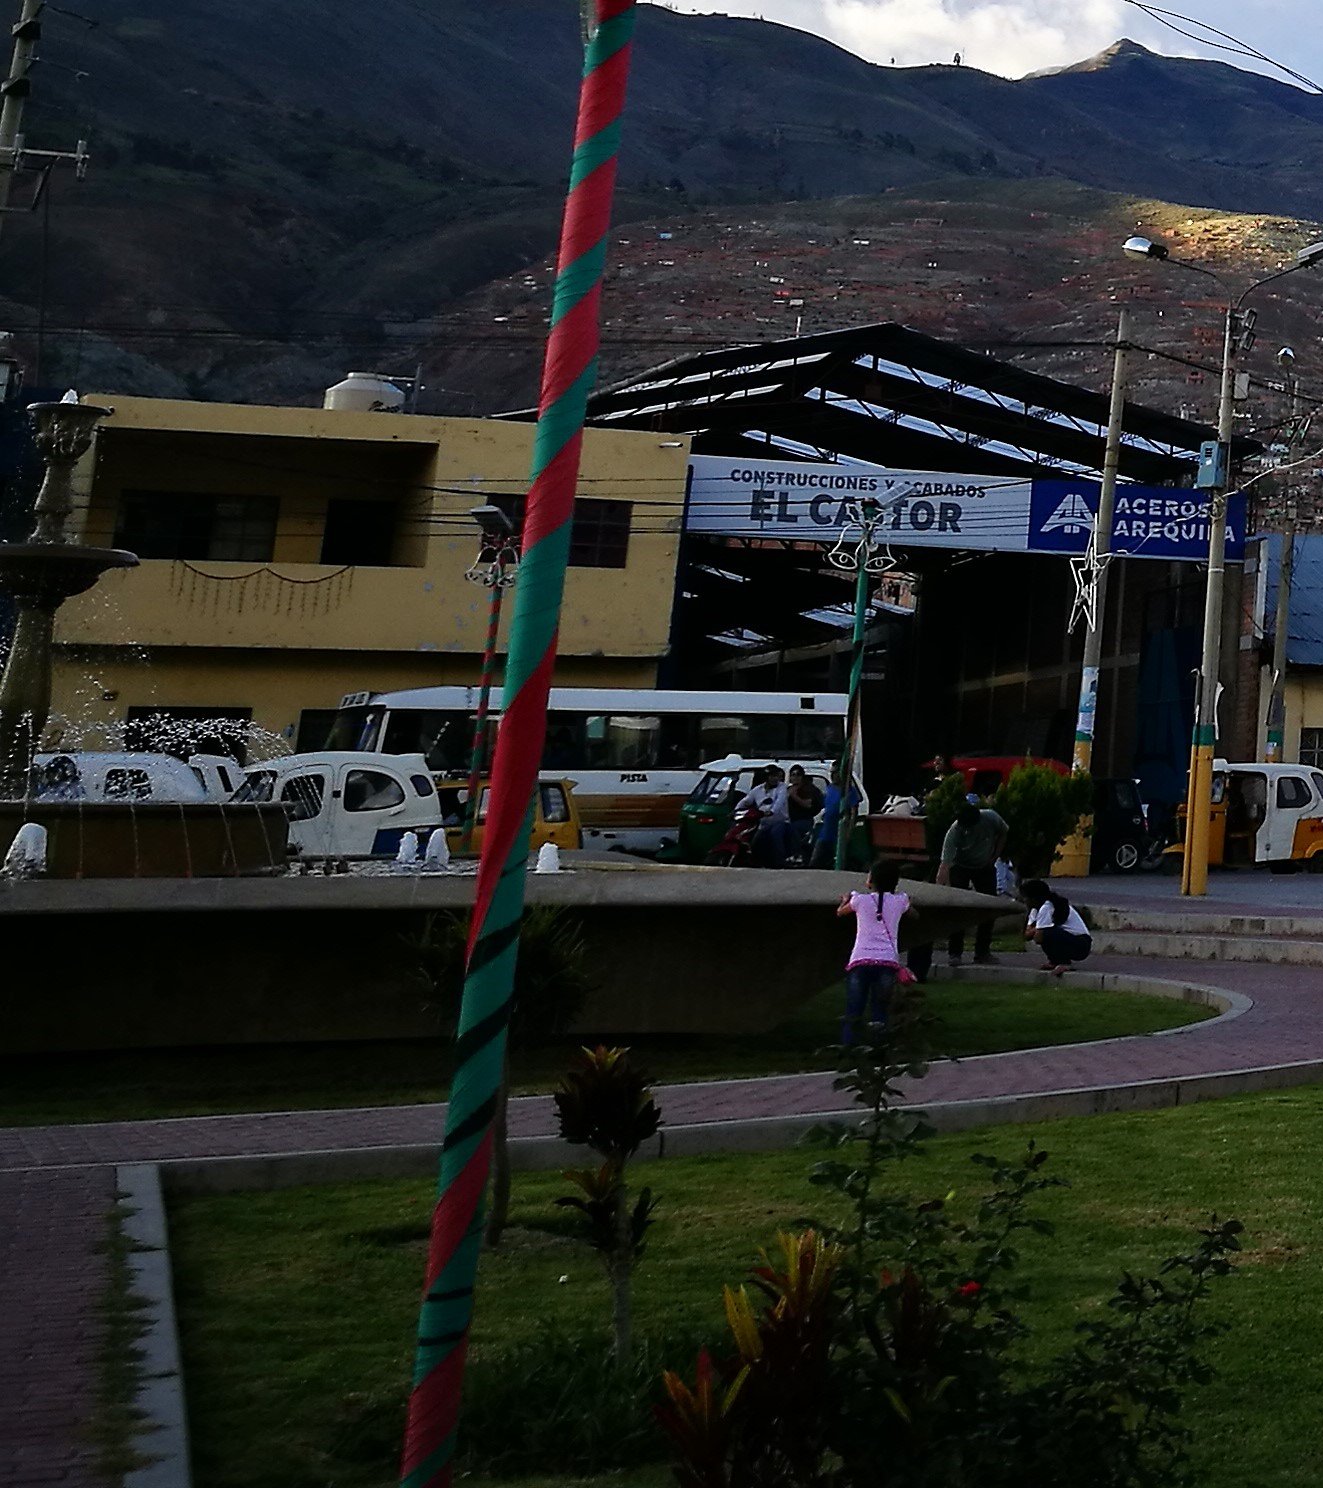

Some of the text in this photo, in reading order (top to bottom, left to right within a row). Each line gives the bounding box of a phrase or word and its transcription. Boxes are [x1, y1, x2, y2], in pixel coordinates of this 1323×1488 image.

[730, 468, 878, 491] CONSTRUCCIONES
[903, 480, 987, 499] CABADOS
[750, 489, 963, 533] EL CATOR
[1114, 497, 1209, 519] ACEROS
[1113, 520, 1236, 543] AREQUIA
